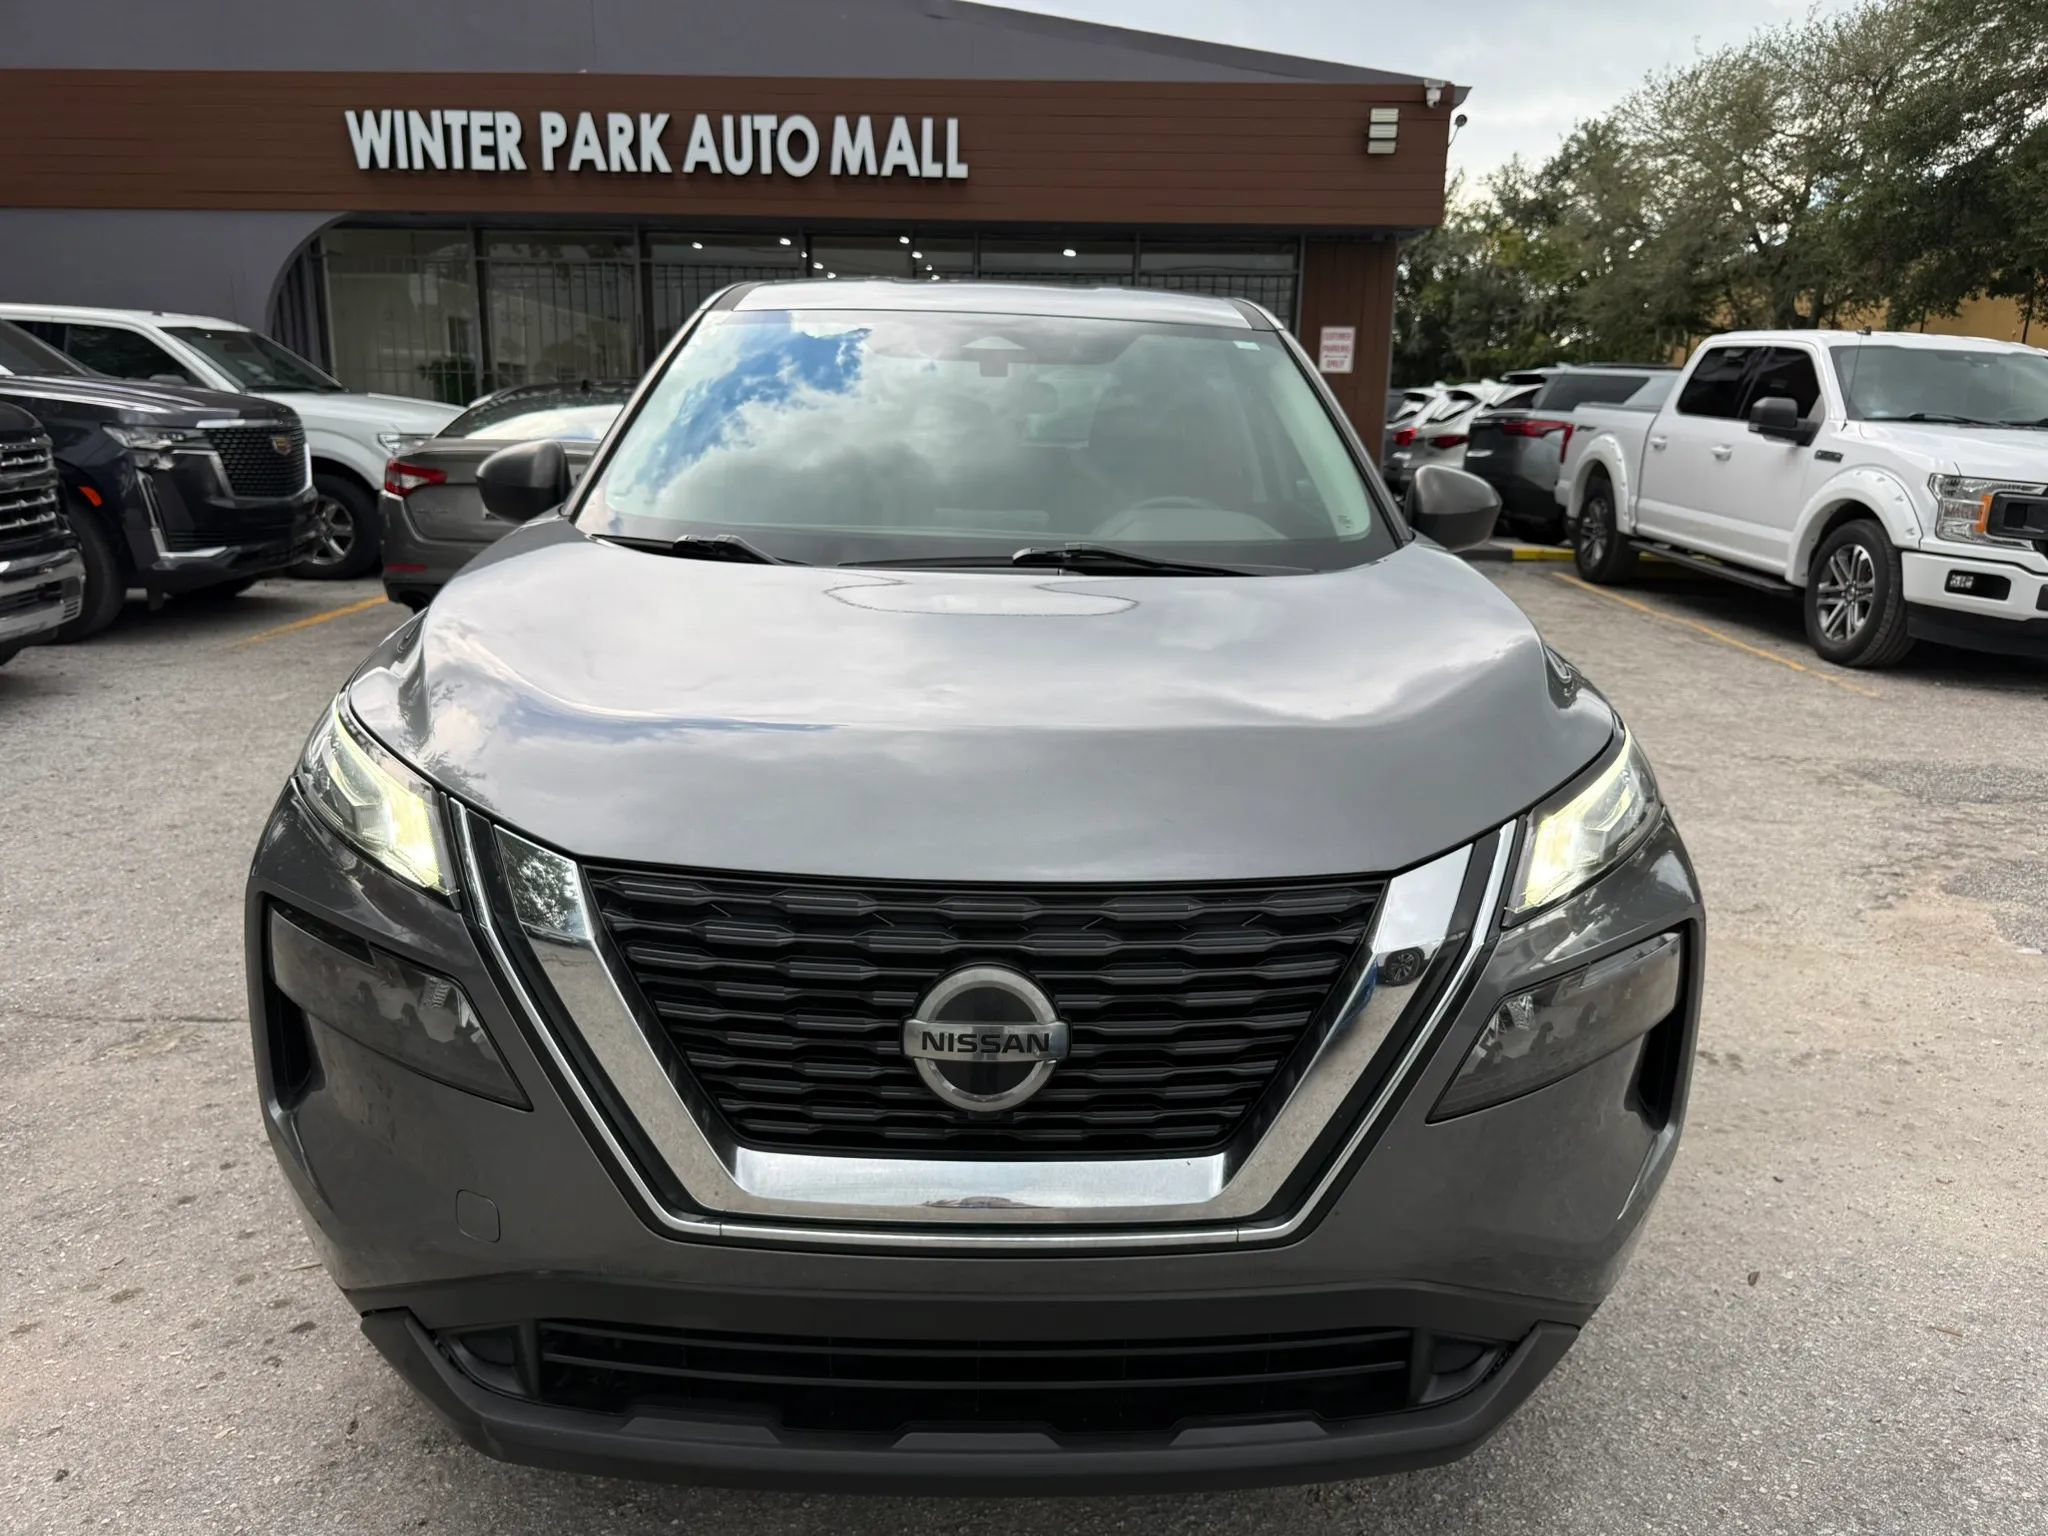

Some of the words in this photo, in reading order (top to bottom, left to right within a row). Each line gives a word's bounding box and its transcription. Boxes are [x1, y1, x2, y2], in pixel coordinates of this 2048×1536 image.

[344, 110, 527, 170] WINTER
[540, 112, 673, 173] PARK
[682, 113, 820, 177] AUTO
[830, 115, 968, 178] MALL
[921, 1031, 1050, 1054] NISSAN
